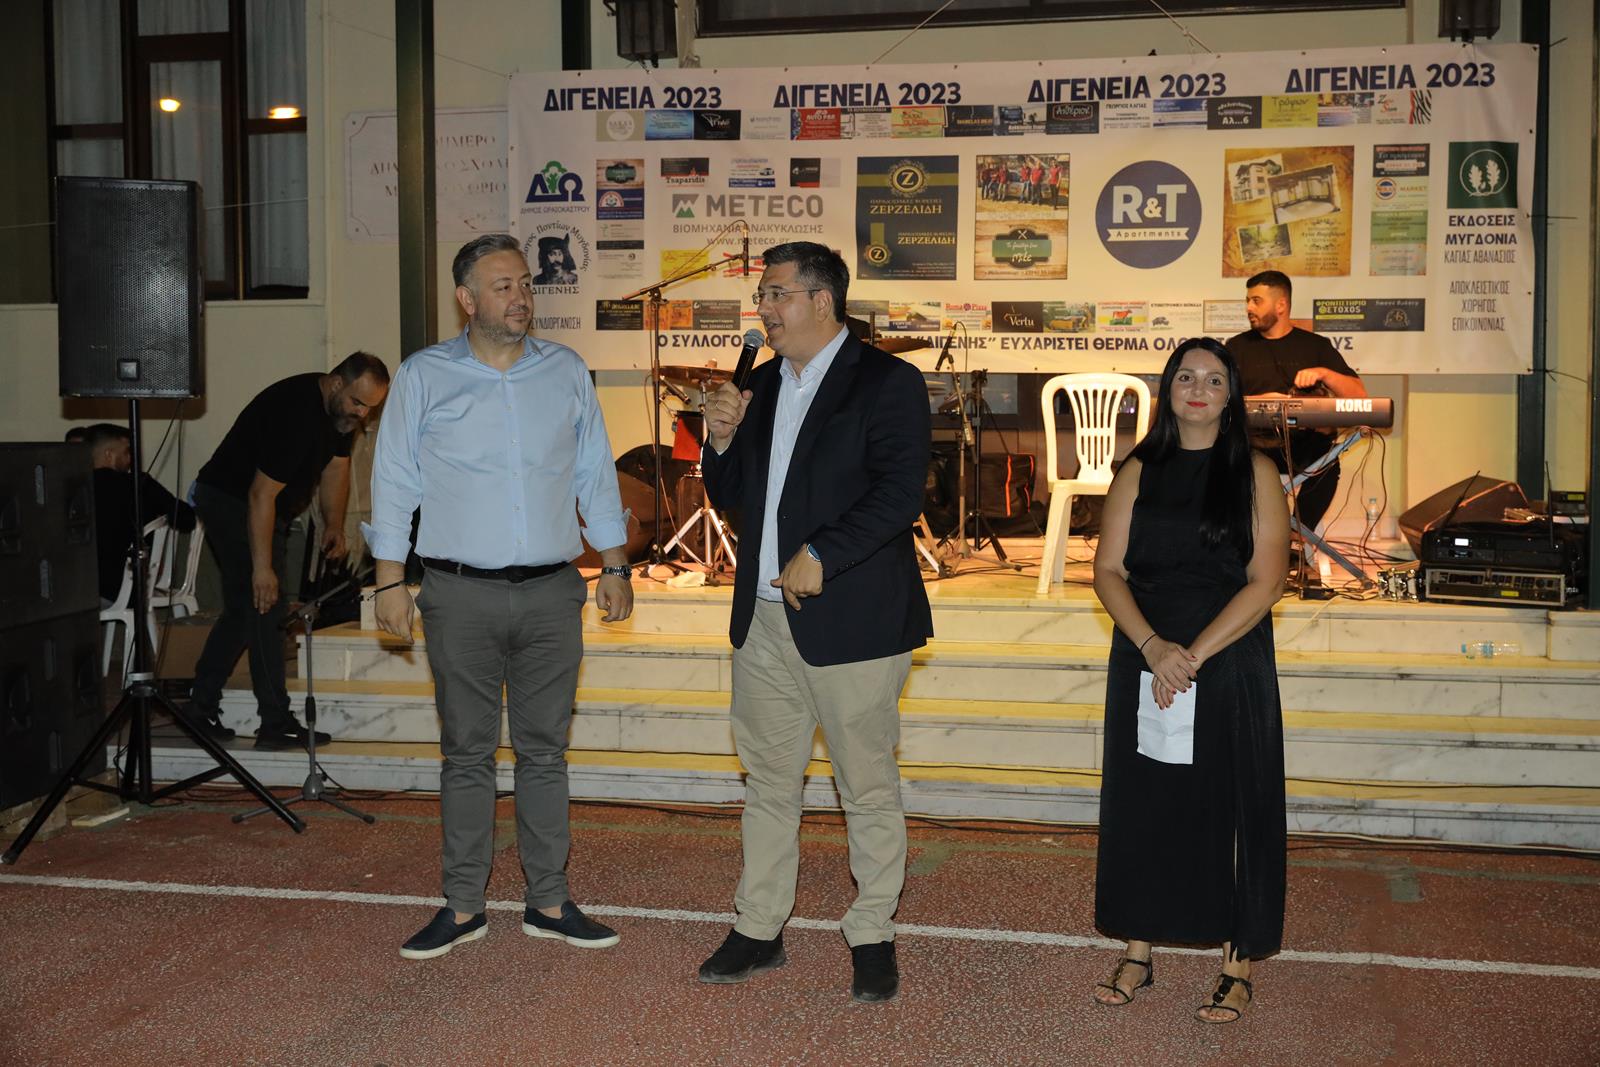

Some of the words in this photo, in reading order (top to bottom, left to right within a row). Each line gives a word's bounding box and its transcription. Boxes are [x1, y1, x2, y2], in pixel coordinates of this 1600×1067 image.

[1285, 65, 1417, 93] ΔΙΓΕΝΕΙΑ
[1426, 62, 1495, 88] 2023
[1027, 76, 1151, 103] ΔΙΓΕΝΕΙΑ
[1160, 73, 1226, 98] 2023
[544, 86, 656, 112] ΔΙΓΕΝΕΙΑ
[663, 86, 722, 109] 2023
[773, 83, 891, 108] ΔΙΓΕΝΕΙΑ
[898, 82, 961, 105] 2023
[706, 195, 823, 218] METECO
[870, 205, 942, 214] ΖΕΡΖΕΛΙΔΗ
[1112, 184, 1188, 224] R&T
[1449, 214, 1516, 226] ΕΚΔΟΣΕΙΣ
[673, 224, 742, 233] ΒΙΟΜΗΧΑΝΙΑ
[1116, 230, 1182, 239] Apartments
[897, 237, 956, 245] ΖΕΡΖΕΛΙΔΗ
[1445, 233, 1518, 245] ΜΥΓΔΟΝΙΑ
[1473, 250, 1516, 263] ΑΘΑΝΑΣΙΟΣ
[532, 286, 580, 295] ΔΙΓΕΝΗΣ
[1450, 280, 1511, 294] ΑΠΟΚΛΕΙΣΤΙΚΟΣ
[1462, 299, 1497, 312] ΧΟΡΗΓΟΣ
[1009, 316, 1035, 327] Vertu
[1452, 317, 1505, 331] ΕΠΙΚΟΙΝΩΝΙΑΣ
[672, 335, 742, 347] ΣΥΛΛΟΓΟ
[1001, 336, 1088, 350] ΕΥΧΑΡΙΣΤΕΙ
[1093, 337, 1149, 350] ΘΕΡΜΑ
[1336, 399, 1372, 412] KORG
